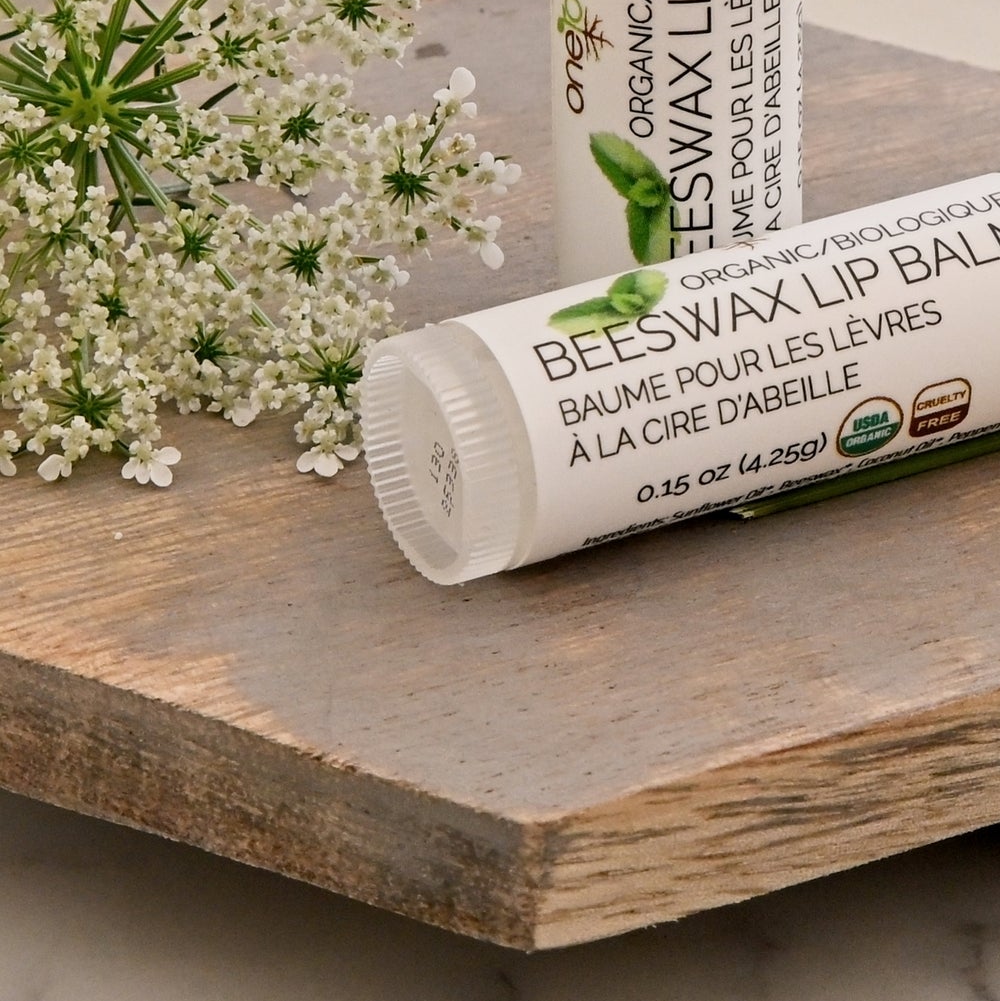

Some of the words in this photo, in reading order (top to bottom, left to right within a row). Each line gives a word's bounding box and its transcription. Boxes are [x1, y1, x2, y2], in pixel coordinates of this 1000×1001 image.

[731, 33, 753, 90] LES
[667, 51, 714, 260] EESWAX
[731, 94, 754, 180] POUR
[764, 140, 782, 210] CIRE
[764, 210, 782, 231] A
[532, 278, 802, 383] BEESWAX
[800, 256, 880, 309] LIP
[558, 372, 672, 427] BAUME
[676, 348, 764, 395] POUR
[767, 331, 824, 370] LES
[828, 299, 943, 353] LÈVRES
[569, 433, 592, 468] À
[597, 426, 637, 460] LA
[642, 403, 711, 446] CIRE
[717, 361, 862, 426] D'ABEILLE
[852, 410, 891, 433] USDA
[916, 389, 968, 412] CRUELTY
[917, 410, 962, 433] FREE
[636, 473, 690, 504] 0.15
[738, 431, 828, 475] (4.25g)
[845, 426, 893, 449] ORGANIC
